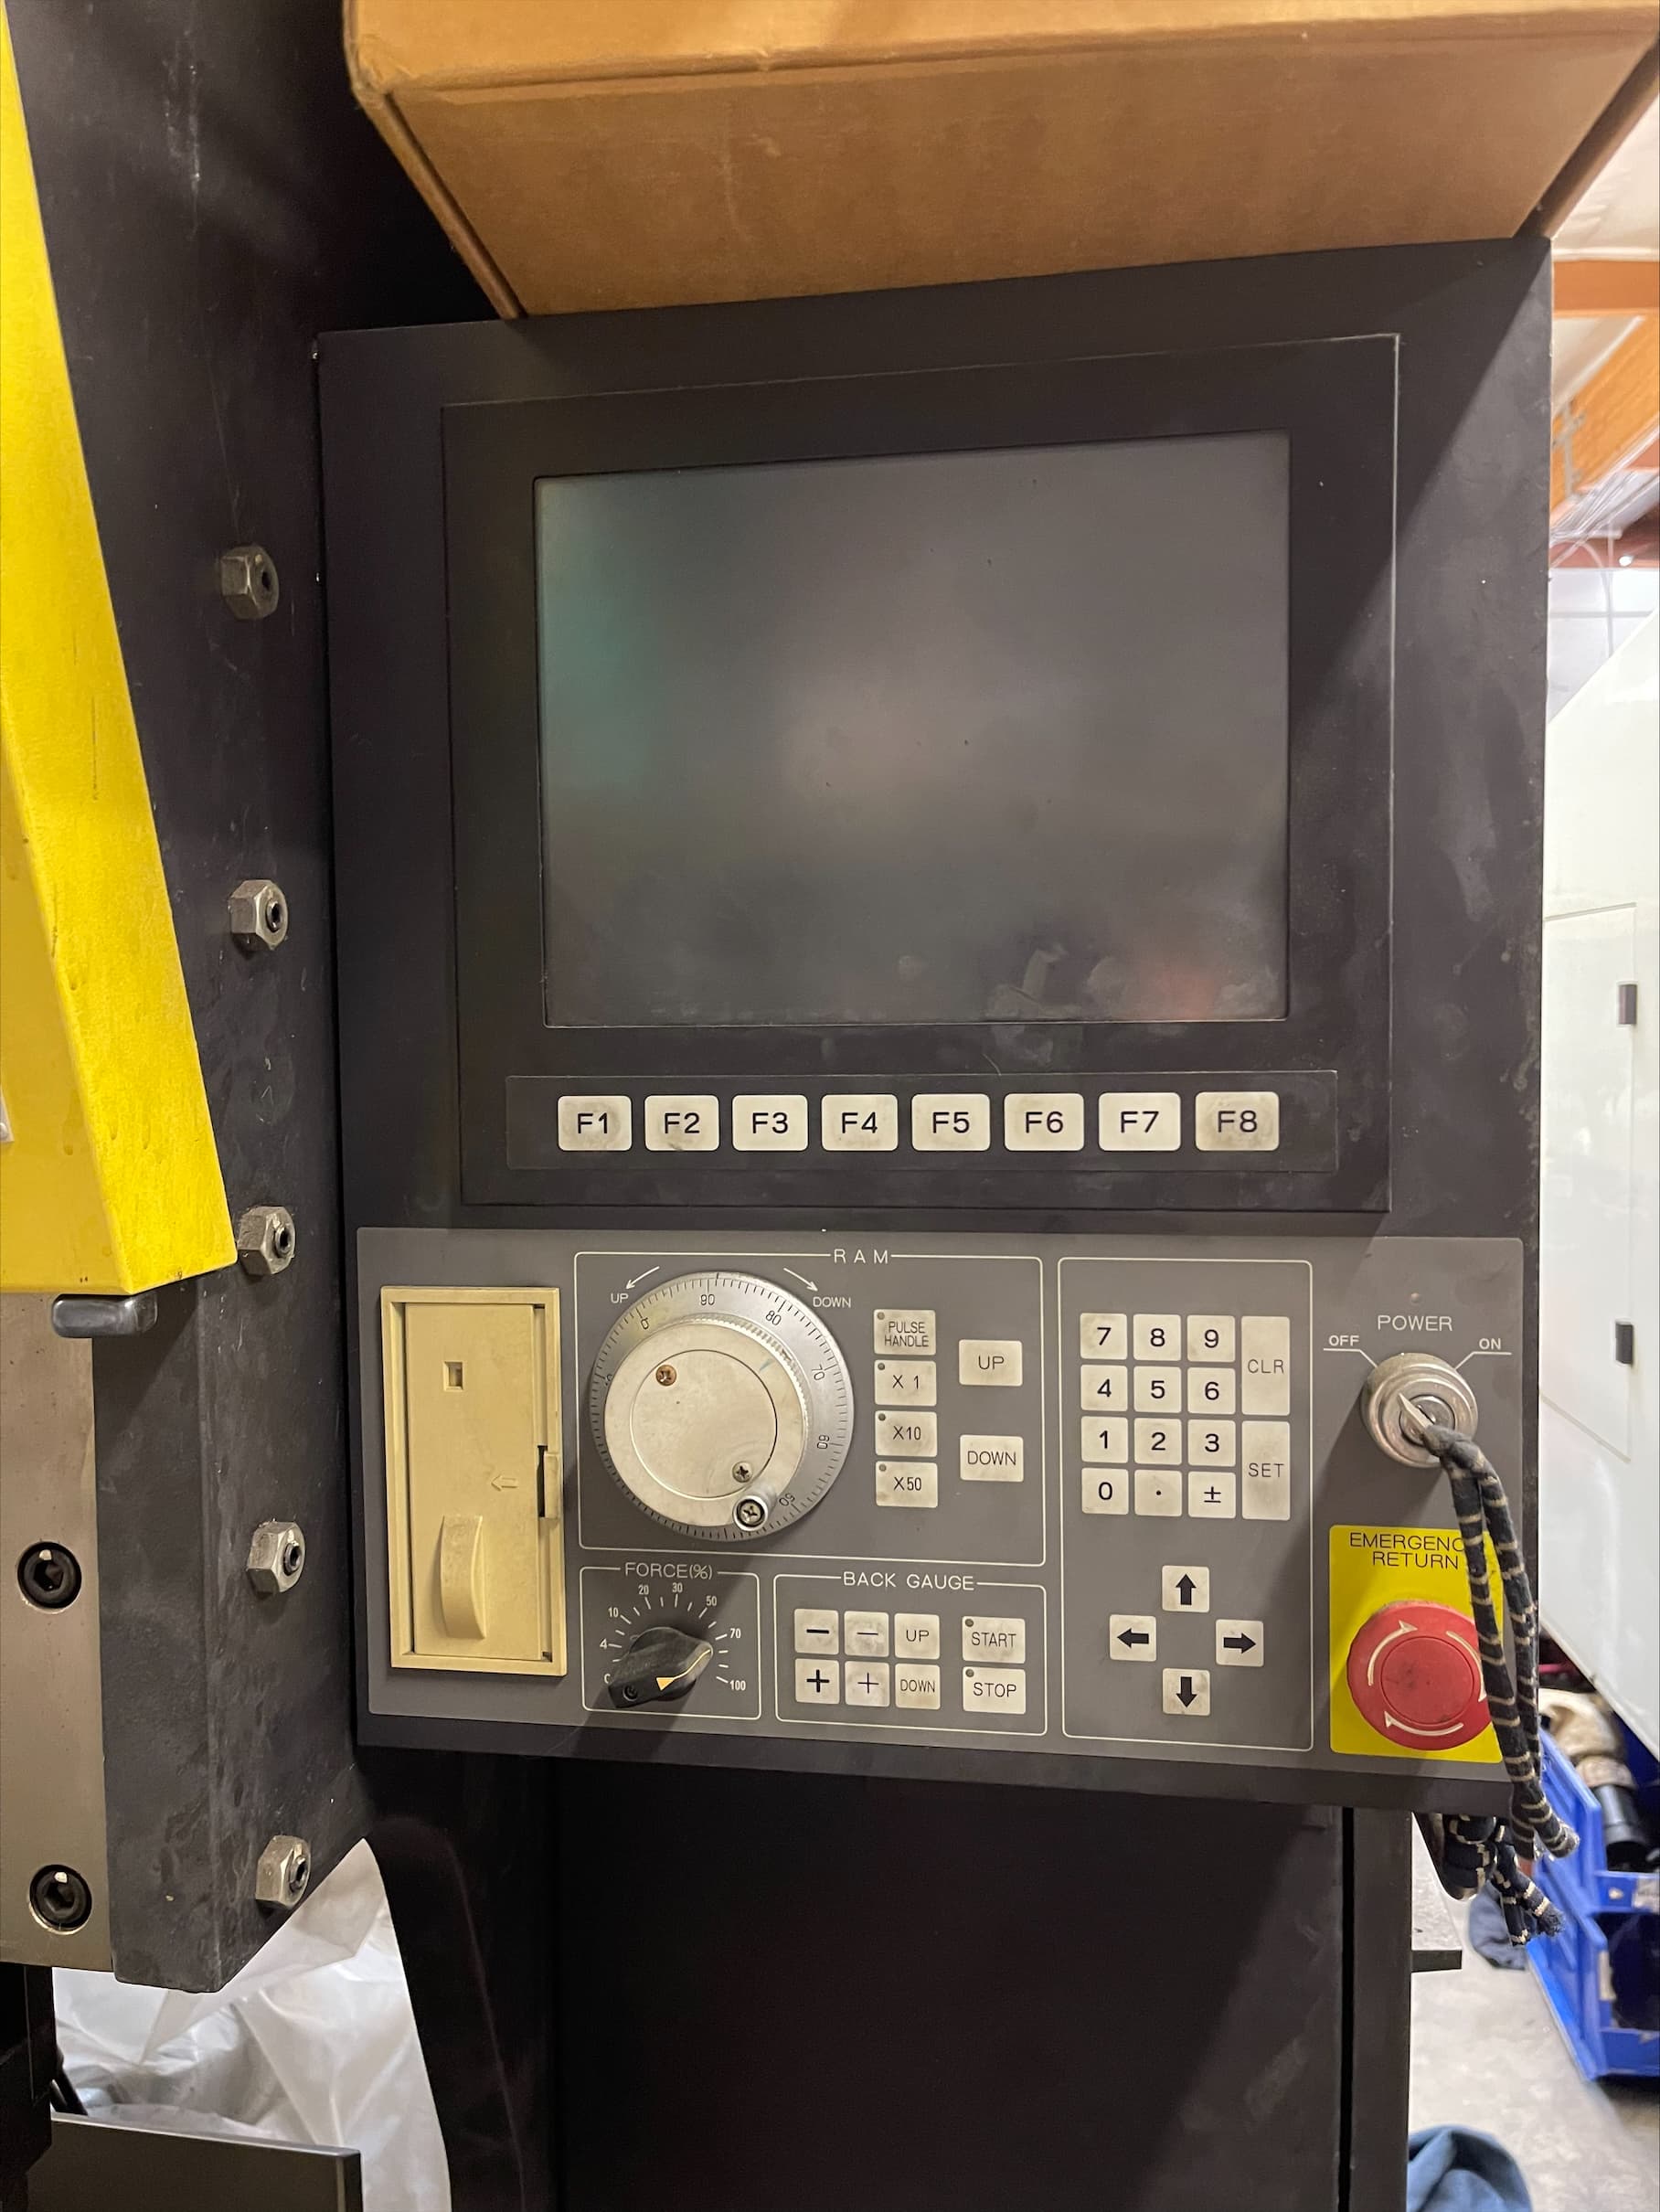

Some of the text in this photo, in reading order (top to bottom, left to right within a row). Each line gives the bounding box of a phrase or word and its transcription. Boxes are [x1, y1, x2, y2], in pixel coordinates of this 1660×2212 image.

[577, 1112, 609, 1134] F1
[664, 1112, 700, 1133] F2
[751, 1112, 789, 1134] F3
[840, 1111, 878, 1134] F4
[931, 1111, 970, 1133] F5
[1025, 1111, 1064, 1133] F6
[1120, 1111, 1159, 1133] F7
[1217, 1110, 1258, 1133] F8
[610, 1292, 629, 1303] UP
[700, 1293, 716, 1305] 90
[813, 1297, 851, 1308] DOWN
[765, 1310, 782, 1325] 80
[1378, 1314, 1452, 1331] POWER
[888, 1322, 926, 1334] PULSE
[1097, 1327, 1112, 1345] 7
[884, 1335, 930, 1347] HANDLE
[1150, 1328, 1165, 1346] 8
[1204, 1329, 1219, 1348] 9
[1328, 1335, 1359, 1347] OFF
[1478, 1337, 1502, 1350] ON
[978, 1356, 1005, 1370] UP
[1247, 1358, 1284, 1374] CLR
[811, 1364, 825, 1381] 70
[1097, 1378, 1112, 1398] 4
[1151, 1380, 1165, 1398] 5
[1205, 1381, 1219, 1400] 6
[893, 1426, 921, 1441] X10
[1099, 1430, 1108, 1449] 1
[1151, 1431, 1166, 1451] 2
[816, 1434, 830, 1450] 60
[1205, 1433, 1219, 1452] 3
[967, 1451, 1016, 1465] DOWN
[1248, 1462, 1285, 1478] SET
[893, 1476, 922, 1492] X50
[1098, 1482, 1113, 1501] 0
[779, 1492, 796, 1506] 50
[1349, 1532, 1464, 1552] EMERGENC
[1372, 1551, 1459, 1569] RETURN
[625, 1562, 713, 1579] FORCE(%)
[672, 1582, 683, 1593] 30
[843, 1571, 974, 1590] BACK GAUGE
[638, 1584, 650, 1595] 20
[706, 1596, 718, 1606] 50
[608, 1607, 619, 1617] 10
[729, 1628, 741, 1639] 70
[906, 1630, 930, 1643] UP
[971, 1632, 1016, 1648] START
[599, 1639, 609, 1649] 4
[729, 1679, 747, 1691] 100
[899, 1679, 935, 1693] DOWN
[973, 1682, 1016, 1697] STOP
